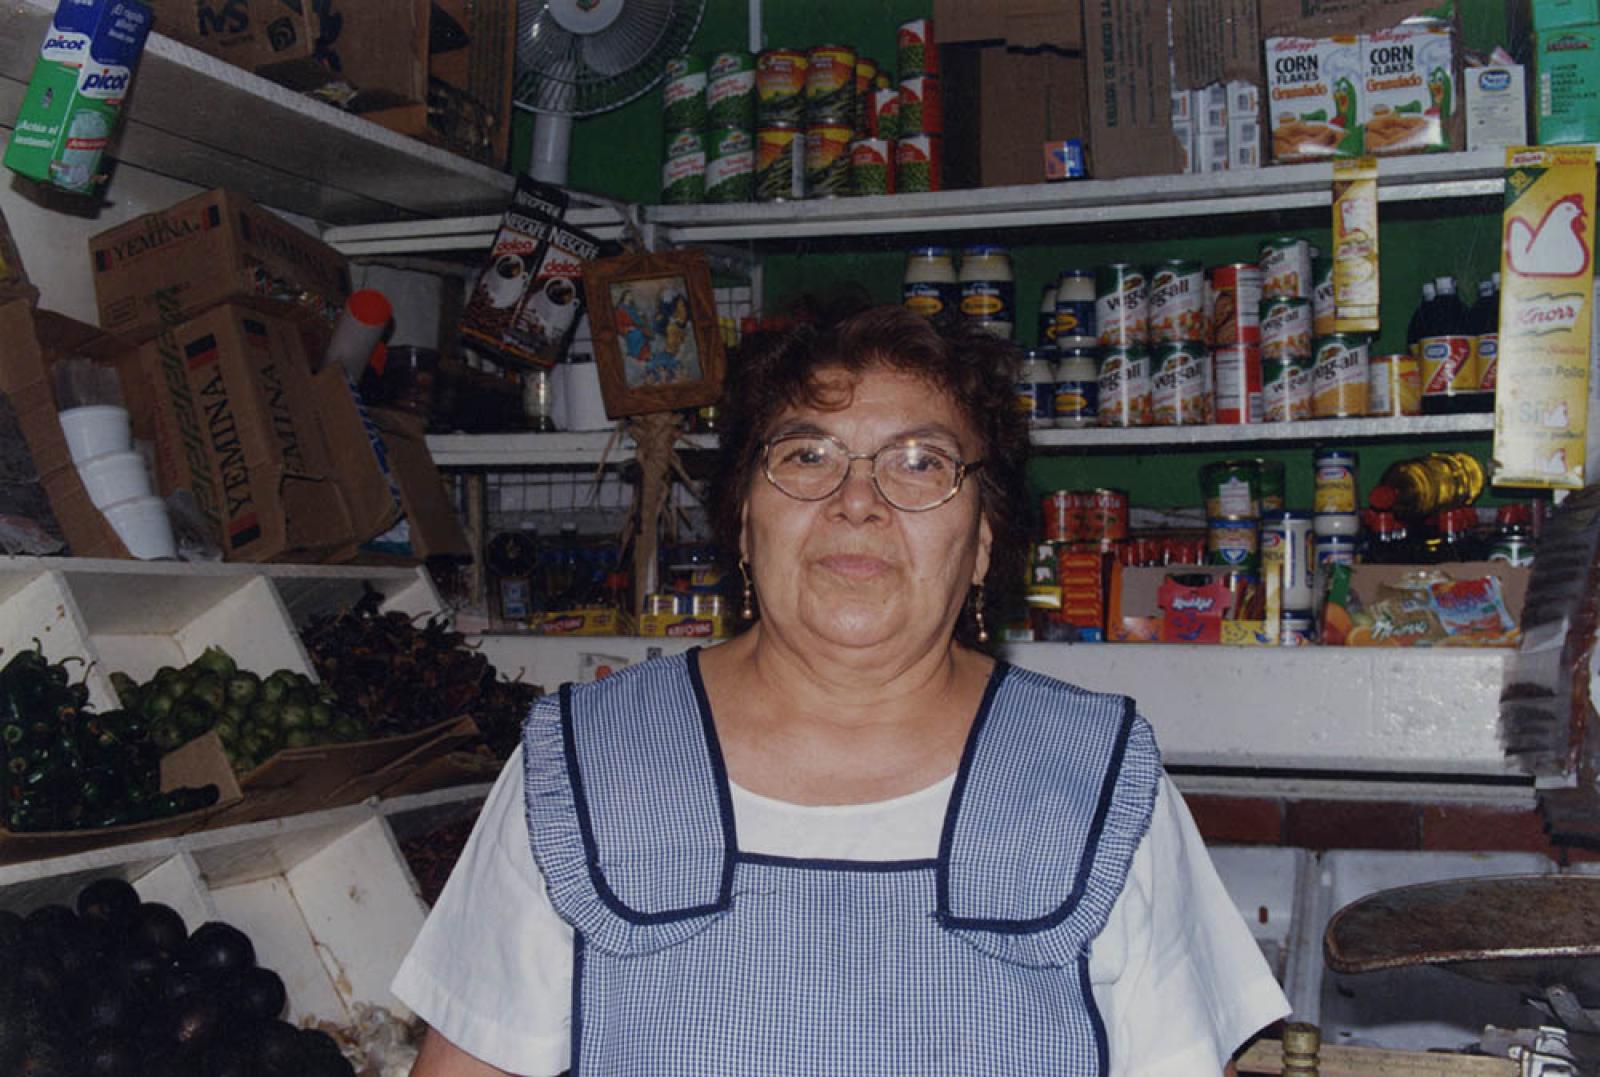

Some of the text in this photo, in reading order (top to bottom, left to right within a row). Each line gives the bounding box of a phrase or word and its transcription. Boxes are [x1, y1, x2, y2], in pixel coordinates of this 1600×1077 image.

[44, 34, 86, 49] picot
[1275, 55, 1319, 74] CORN
[1369, 45, 1413, 65] CORN
[81, 68, 129, 91] picot
[1277, 72, 1319, 85] FLAKES
[1371, 64, 1414, 76] FLAKES
[1518, 302, 1577, 326] Knorr
[200, 374, 253, 518] YEMINA
